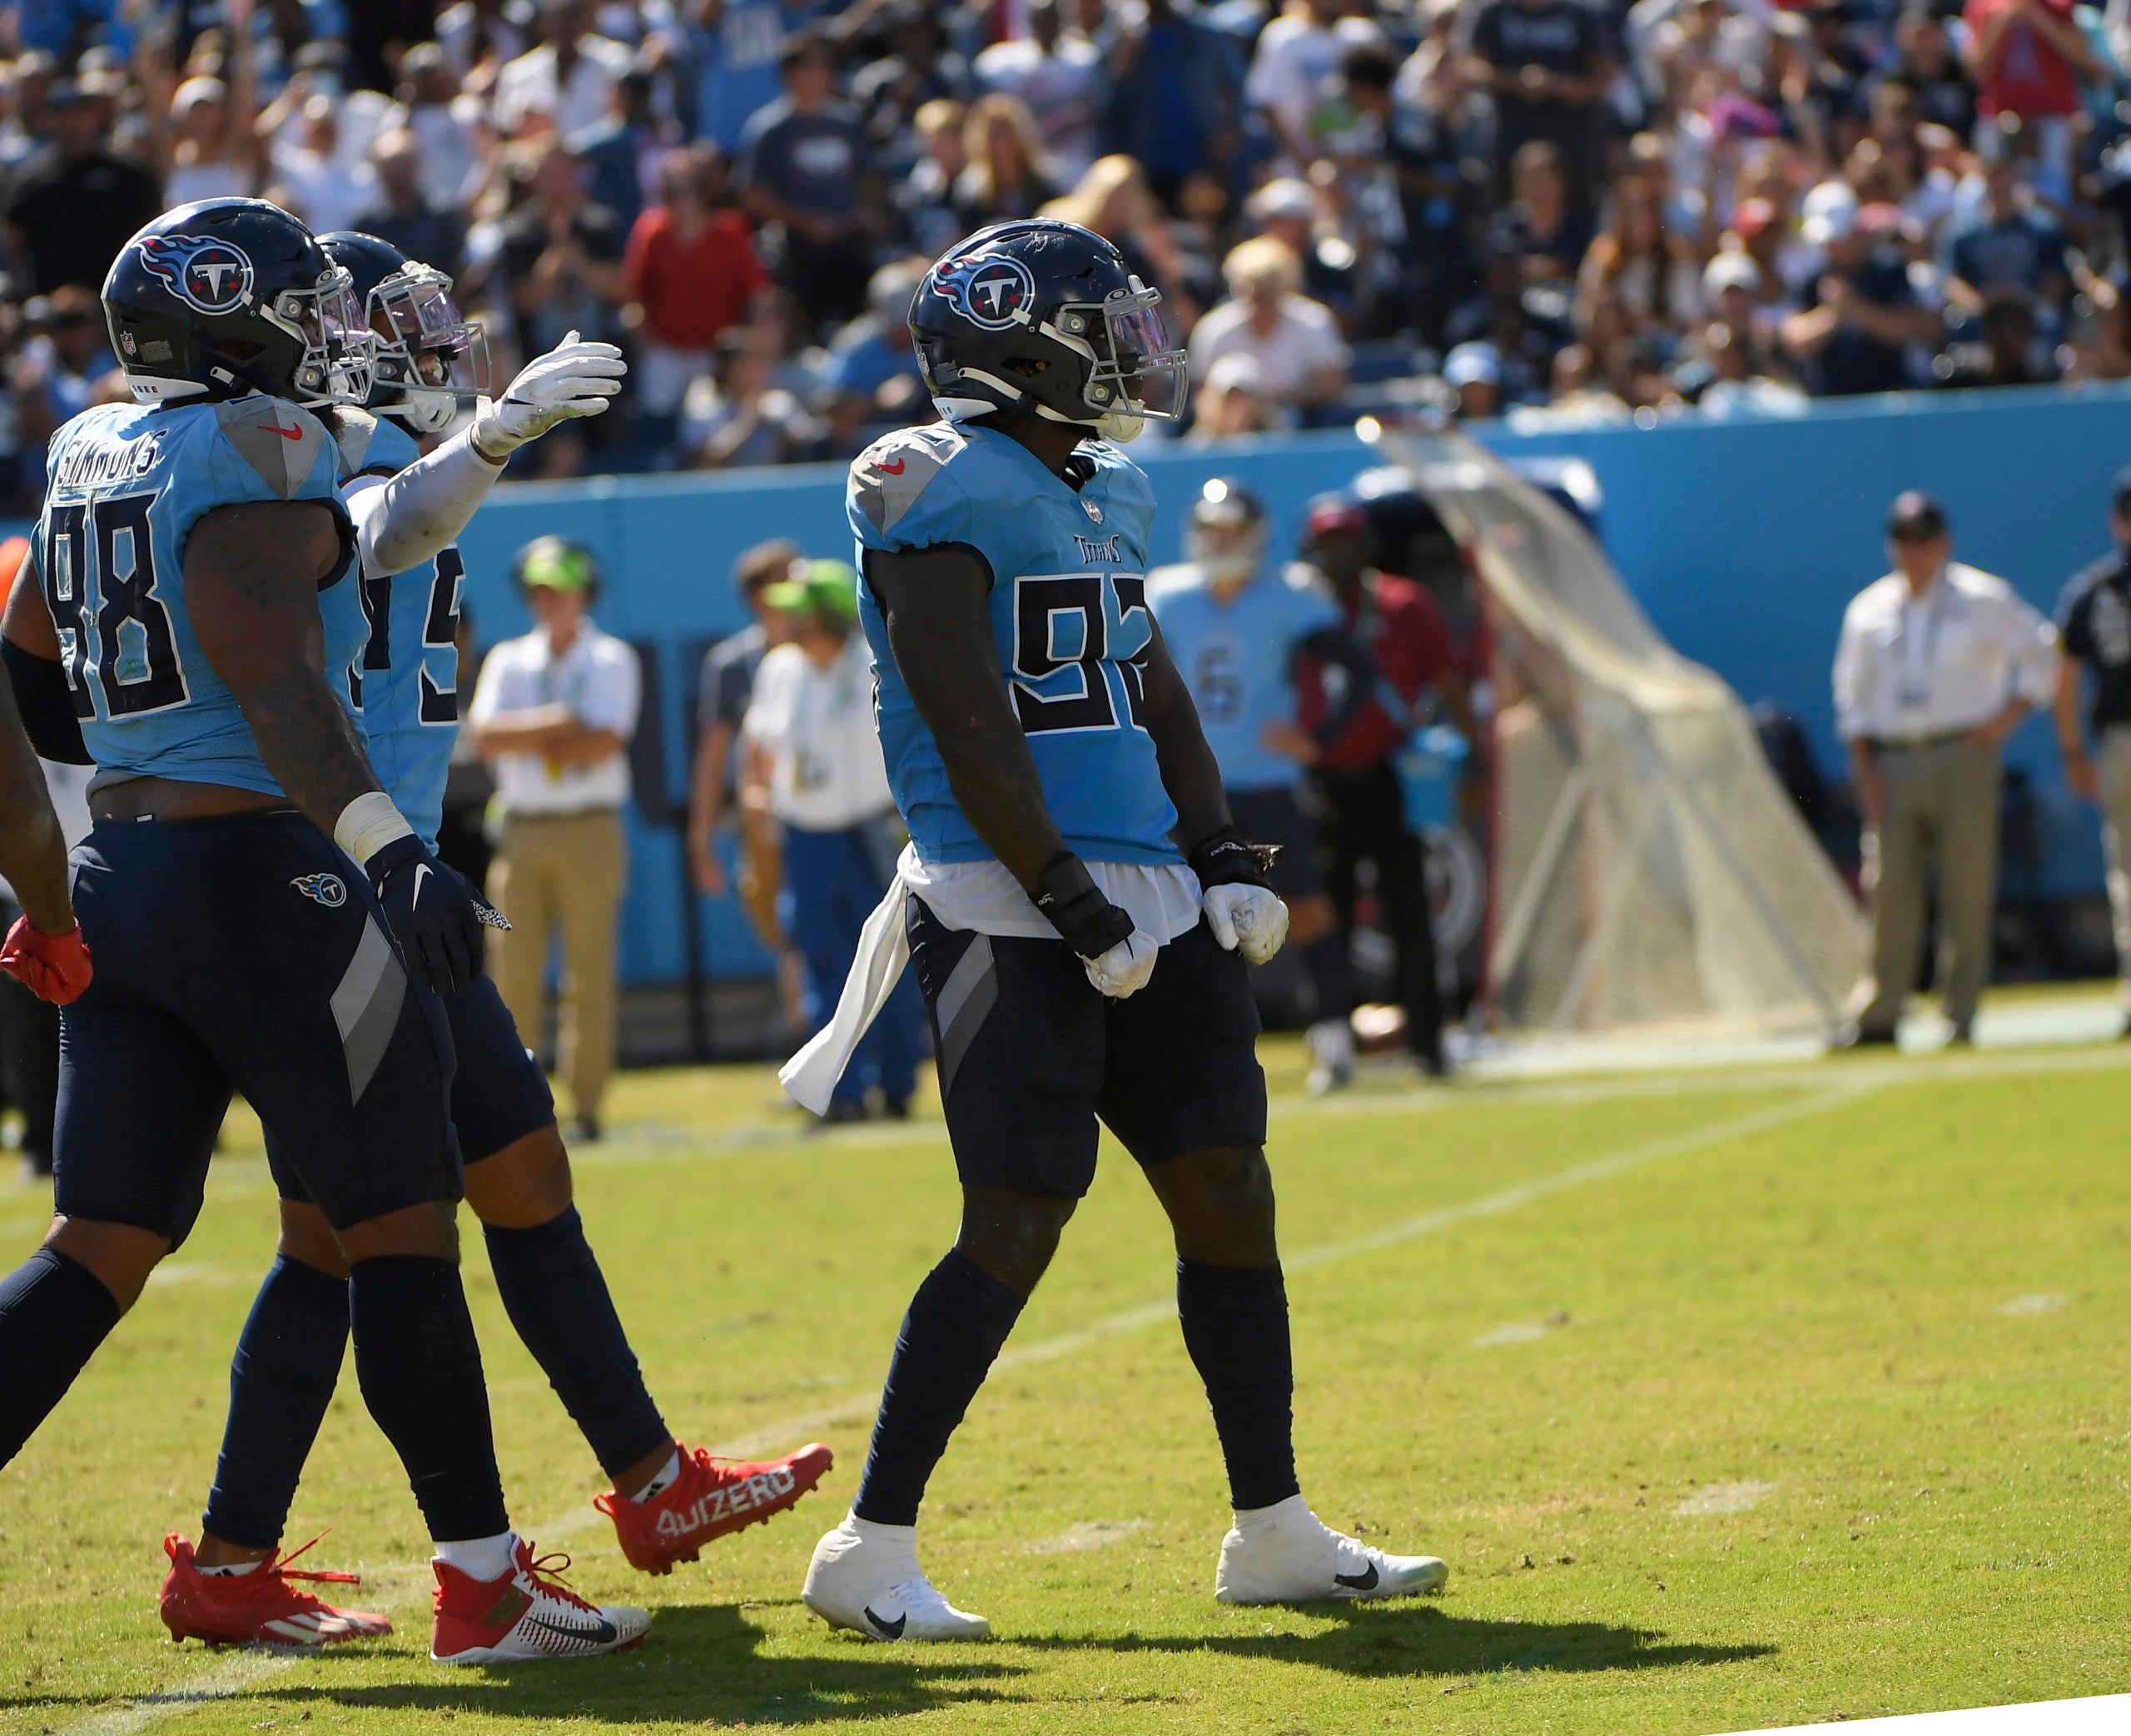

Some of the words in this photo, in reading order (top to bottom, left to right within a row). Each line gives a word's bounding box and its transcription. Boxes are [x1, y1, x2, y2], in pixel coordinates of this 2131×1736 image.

[57, 428, 169, 486] SIMMONS
[1072, 533, 1122, 565] TITANS
[45, 488, 191, 722] 98
